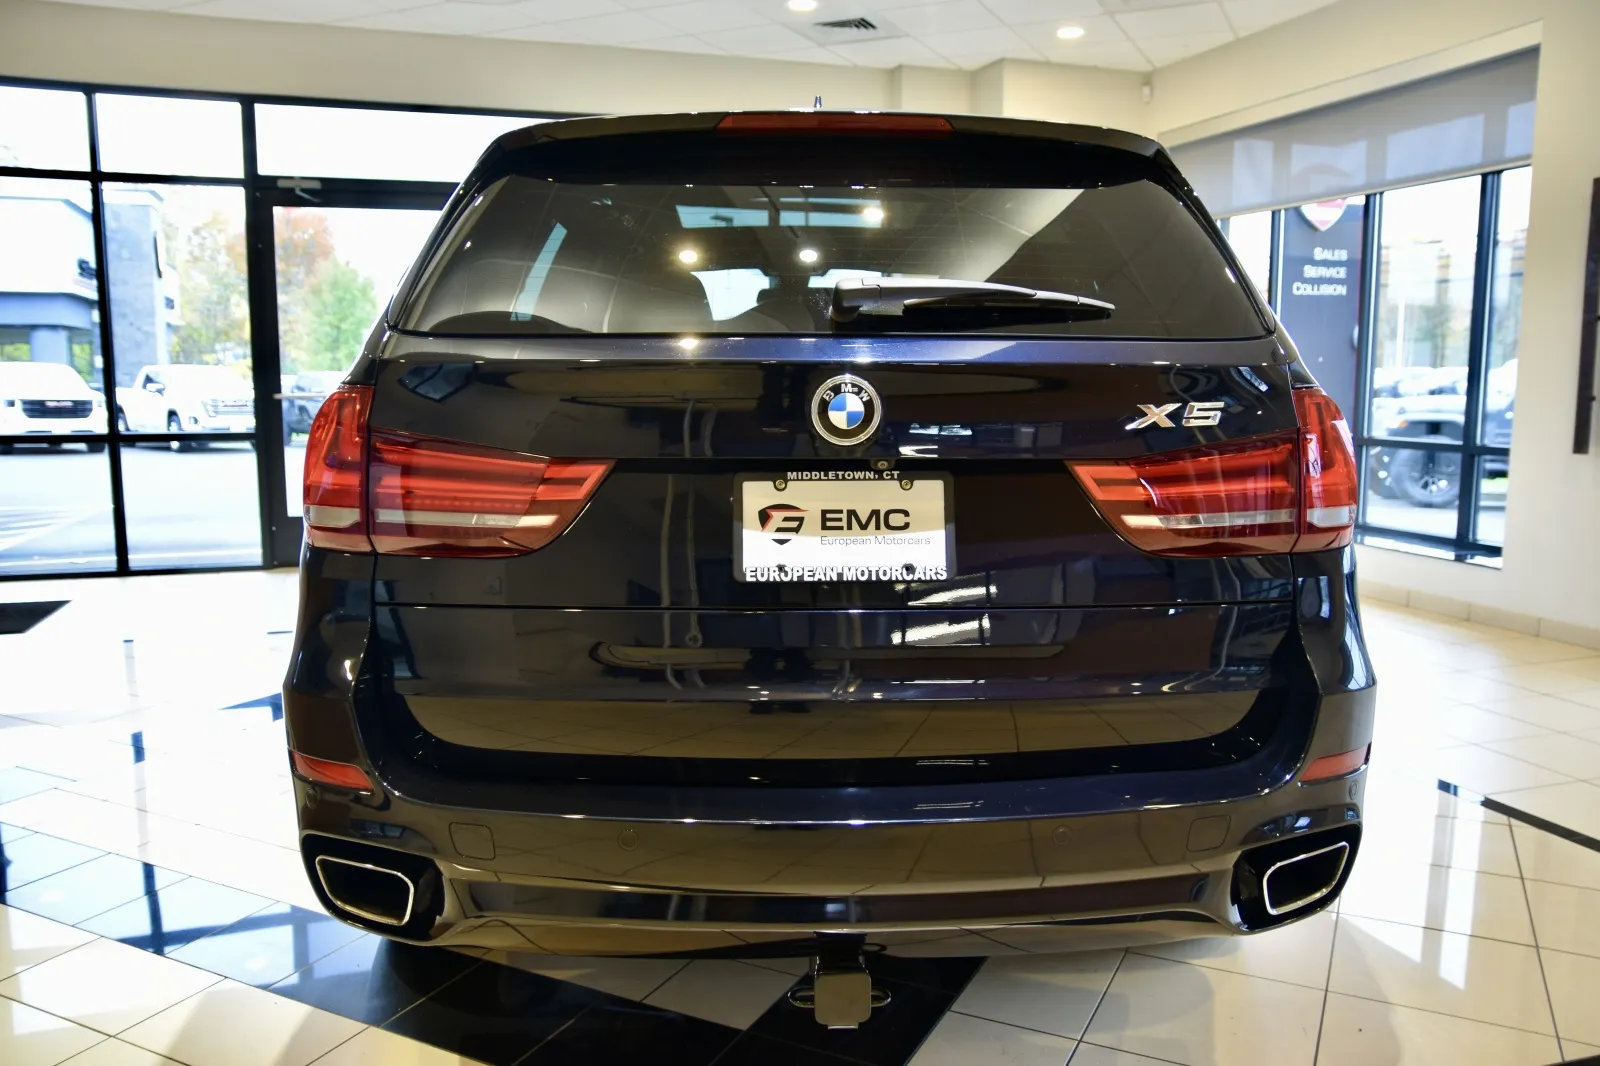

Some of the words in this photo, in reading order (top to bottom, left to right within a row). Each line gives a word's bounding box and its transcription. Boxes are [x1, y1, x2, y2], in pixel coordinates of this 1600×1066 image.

[822, 383, 870, 402] BMW
[787, 471, 879, 480] MIDDLETOWN,
[883, 471, 900, 480] CT
[820, 508, 911, 531] EMC
[820, 536, 871, 546] European
[874, 536, 931, 545] Motorcars
[745, 566, 837, 582] EUROPEAN
[843, 565, 948, 581] MOTORCARS
